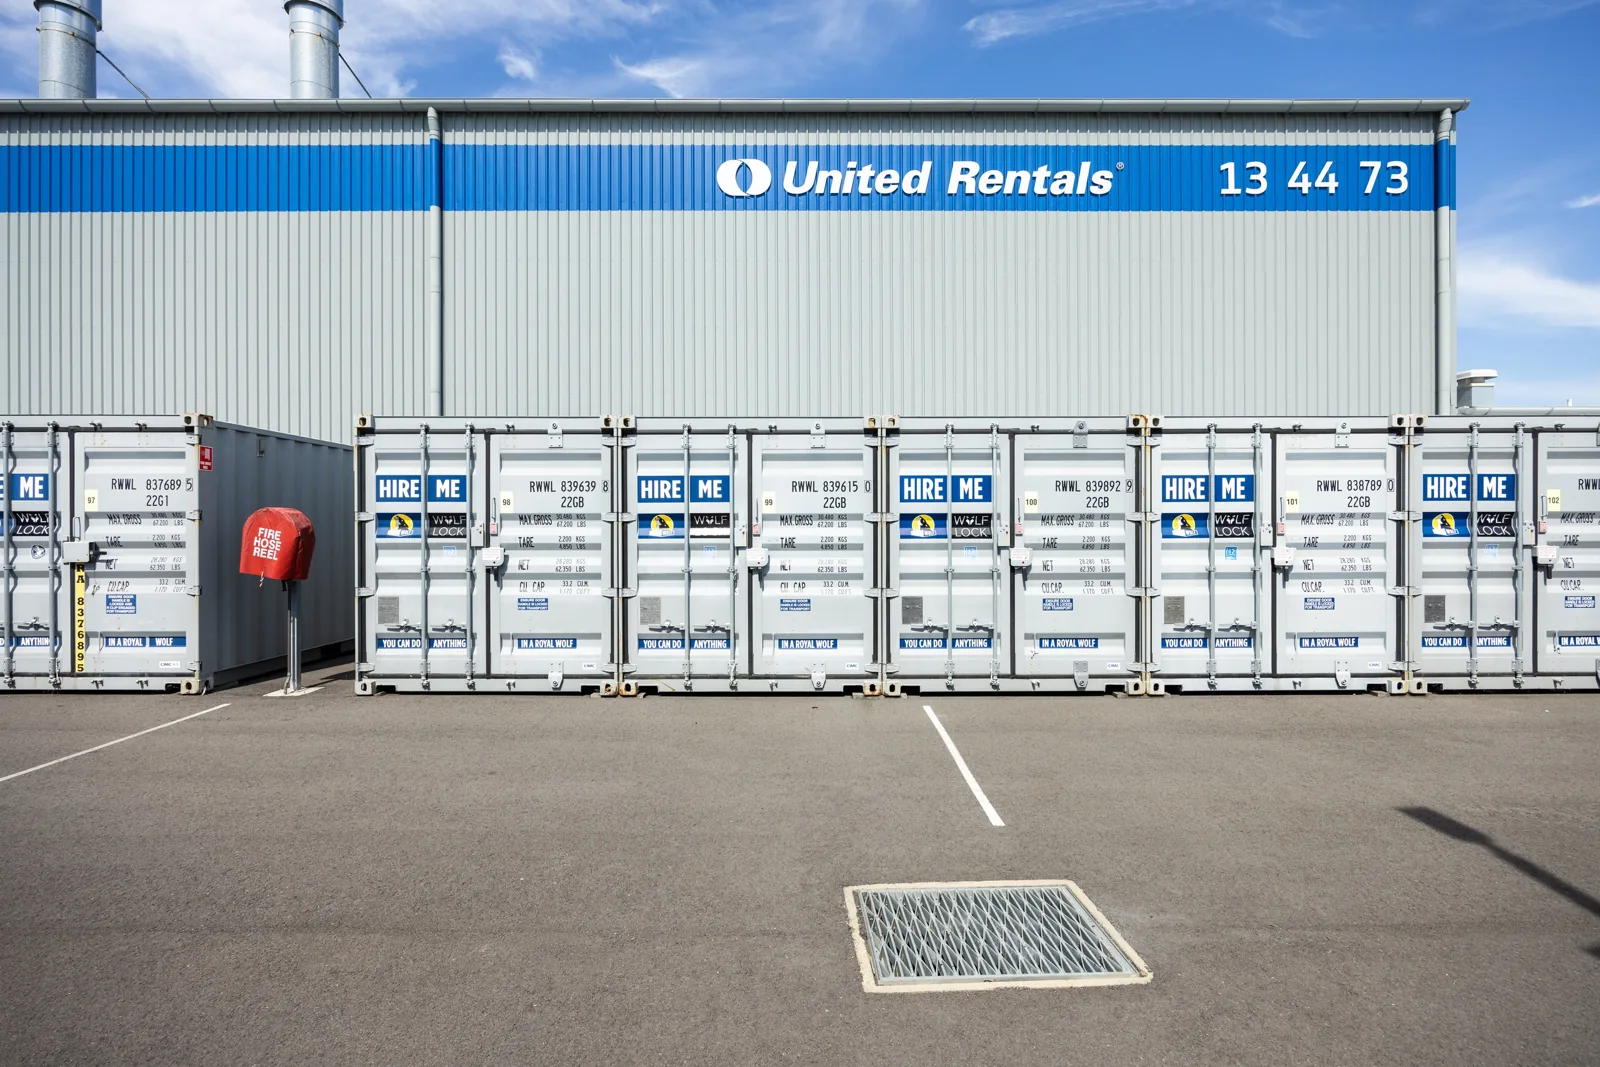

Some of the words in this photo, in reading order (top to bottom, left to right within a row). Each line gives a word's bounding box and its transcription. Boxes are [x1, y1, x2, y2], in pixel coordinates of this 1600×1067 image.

[783, 161, 932, 196] United
[1219, 162, 1268, 195] 13
[1287, 162, 1339, 195] 44
[1361, 162, 1409, 195] 73
[20, 476, 43, 498] ME
[112, 479, 136, 490] RWWL
[146, 479, 181, 490] 837689
[187, 479, 192, 490] 5
[380, 480, 419, 498] HIRE
[436, 480, 460, 498] ME
[529, 481, 556, 493] RWWL
[561, 481, 596, 493] 839639
[603, 481, 608, 493] 8
[641, 480, 681, 498] HIRE
[699, 480, 722, 498] ME
[792, 481, 818, 493] RWWL
[823, 481, 858, 493] 839615
[865, 481, 870, 492] 0
[904, 478, 943, 499] HIRE
[960, 478, 983, 499] ME
[1056, 481, 1080, 492] RWWL
[1086, 481, 1120, 492] 839892
[1126, 480, 1132, 492] 9
[1166, 478, 1205, 499] HIRE
[1222, 478, 1245, 499] ME
[1317, 480, 1342, 491] RWWL
[1347, 480, 1382, 491] 838789
[1388, 480, 1394, 491] 0
[1427, 477, 1466, 498] HIRE
[1484, 477, 1506, 498] ME
[147, 495, 168, 506] 22G1
[561, 496, 584, 508] 22GB
[823, 497, 847, 508] 22GB
[1086, 497, 1109, 508] 22GB
[1347, 496, 1370, 507] 22GB
[258, 528, 281, 540] FIRE
[432, 527, 464, 536] LOCK
[955, 528, 987, 537] LOCK
[1217, 526, 1249, 536] LOCK
[1477, 526, 1510, 536] LOCK
[254, 537, 281, 551] HOSE
[518, 537, 534, 547] TARE
[780, 538, 796, 548] TARE
[1043, 538, 1058, 548] TARE
[1303, 537, 1318, 547] TARE
[1564, 535, 1579, 545] TARE
[253, 547, 278, 561] REEL
[518, 560, 530, 570] NET
[1042, 560, 1053, 571] NET
[1303, 560, 1314, 570] NET
[1562, 558, 1575, 568] NET
[109, 638, 115, 646] IN
[116, 638, 122, 646] A
[124, 638, 143, 646] ROYAL
[156, 638, 173, 646] WOLF
[383, 640, 397, 648] YOU
[398, 640, 409, 648] CAN
[410, 640, 420, 648] DO
[433, 640, 466, 648] ANYTHING
[521, 640, 527, 648] IN
[528, 640, 533, 648] A
[535, 640, 554, 648] ROYAL
[555, 640, 573, 648] WOLF
[644, 640, 658, 648] YOU
[659, 640, 670, 648] CAN
[672, 640, 681, 648] DO
[694, 640, 726, 648] ANYTHING
[782, 640, 788, 648] IN
[789, 640, 794, 648] A
[795, 640, 815, 648] ROYAL
[816, 640, 834, 648] WOLF
[905, 639, 919, 648] YOU
[920, 639, 932, 648] CAN
[933, 639, 942, 648] DO
[955, 639, 987, 648] ANYTHING
[1042, 639, 1048, 648] IN
[1050, 639, 1055, 648] A
[1057, 639, 1076, 648] ROYAL
[1078, 639, 1095, 648] WOLF
[1165, 639, 1179, 647] YOU
[1180, 639, 1192, 647] CAN
[1193, 639, 1202, 647] DO
[1216, 639, 1247, 647] ANYTHING
[1302, 639, 1308, 647] IN
[1310, 639, 1315, 647] A
[1317, 639, 1336, 647] ROYAL
[1338, 639, 1355, 647] WOLF
[1562, 637, 1568, 645] IN
[1569, 637, 1575, 645] A
[1575, 637, 1596, 645] ROYAL
